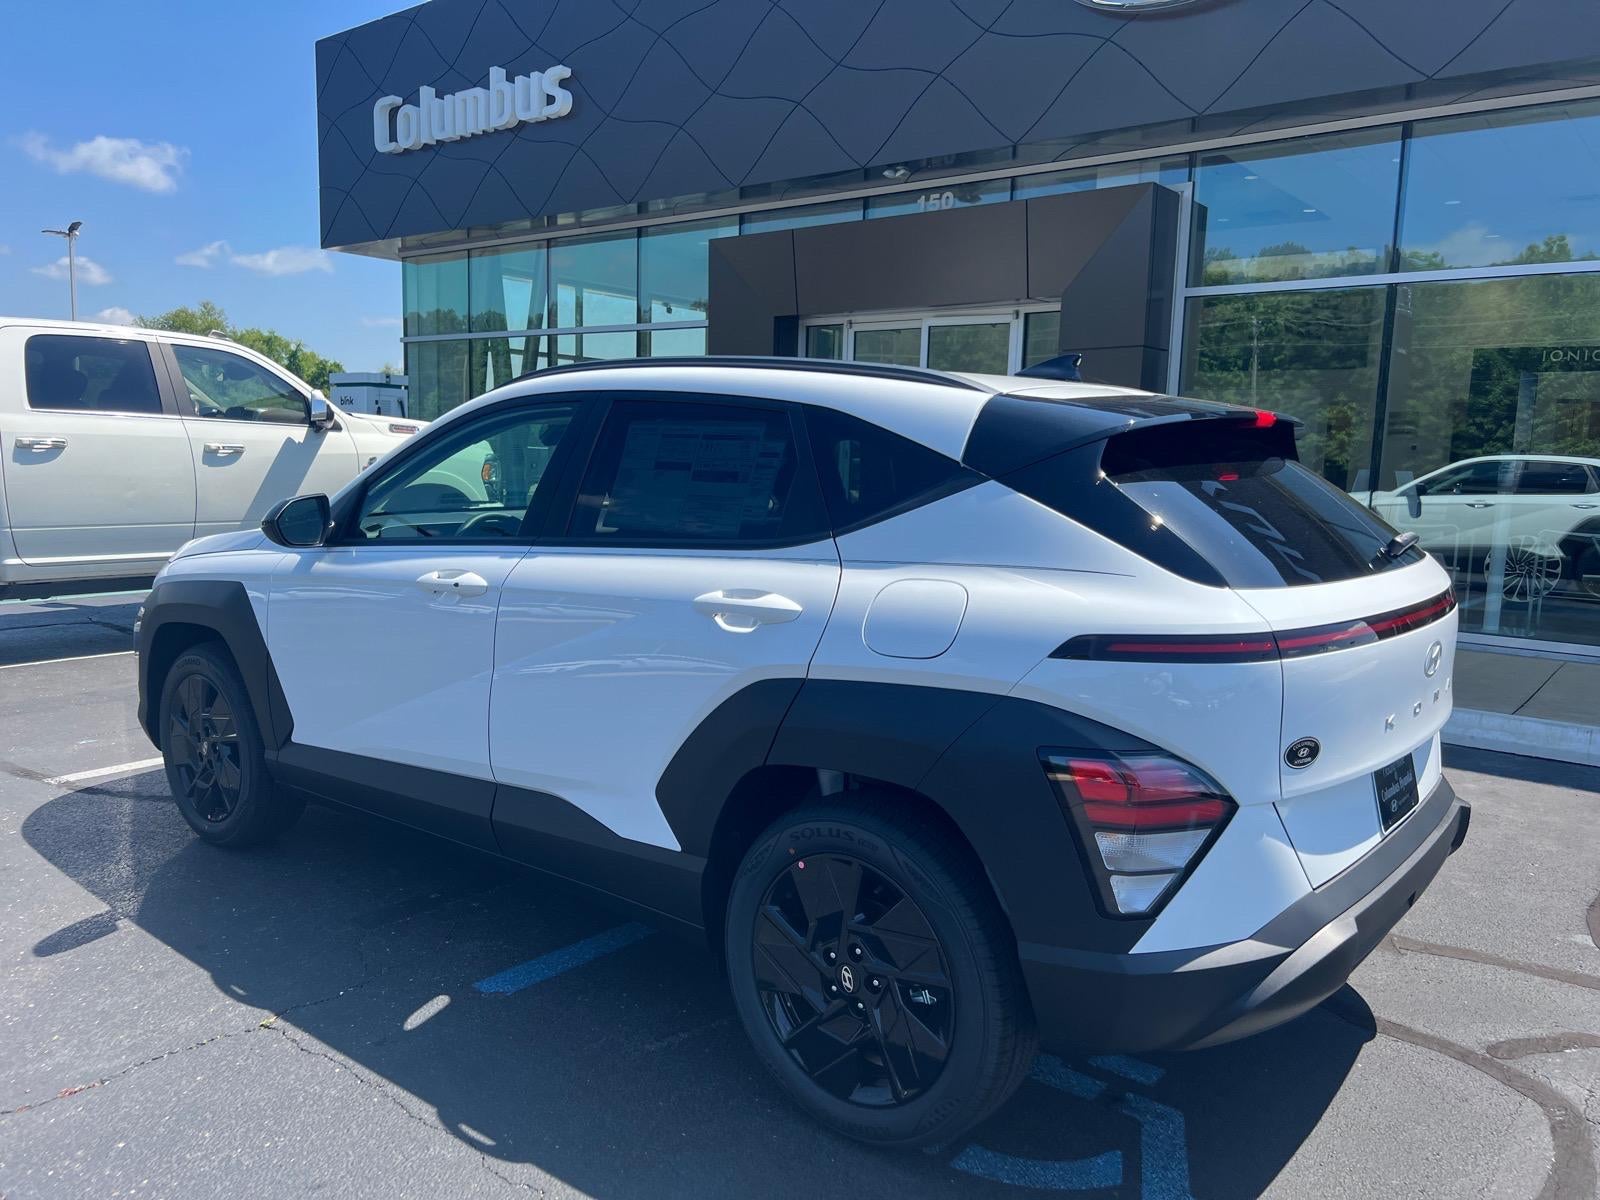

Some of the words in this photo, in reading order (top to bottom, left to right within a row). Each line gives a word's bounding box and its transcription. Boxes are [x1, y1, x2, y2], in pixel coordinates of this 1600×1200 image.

[373, 64, 573, 154] Columbus
[917, 191, 954, 212] 150
[340, 395, 354, 406] blink
[789, 827, 856, 842] SOLUS
